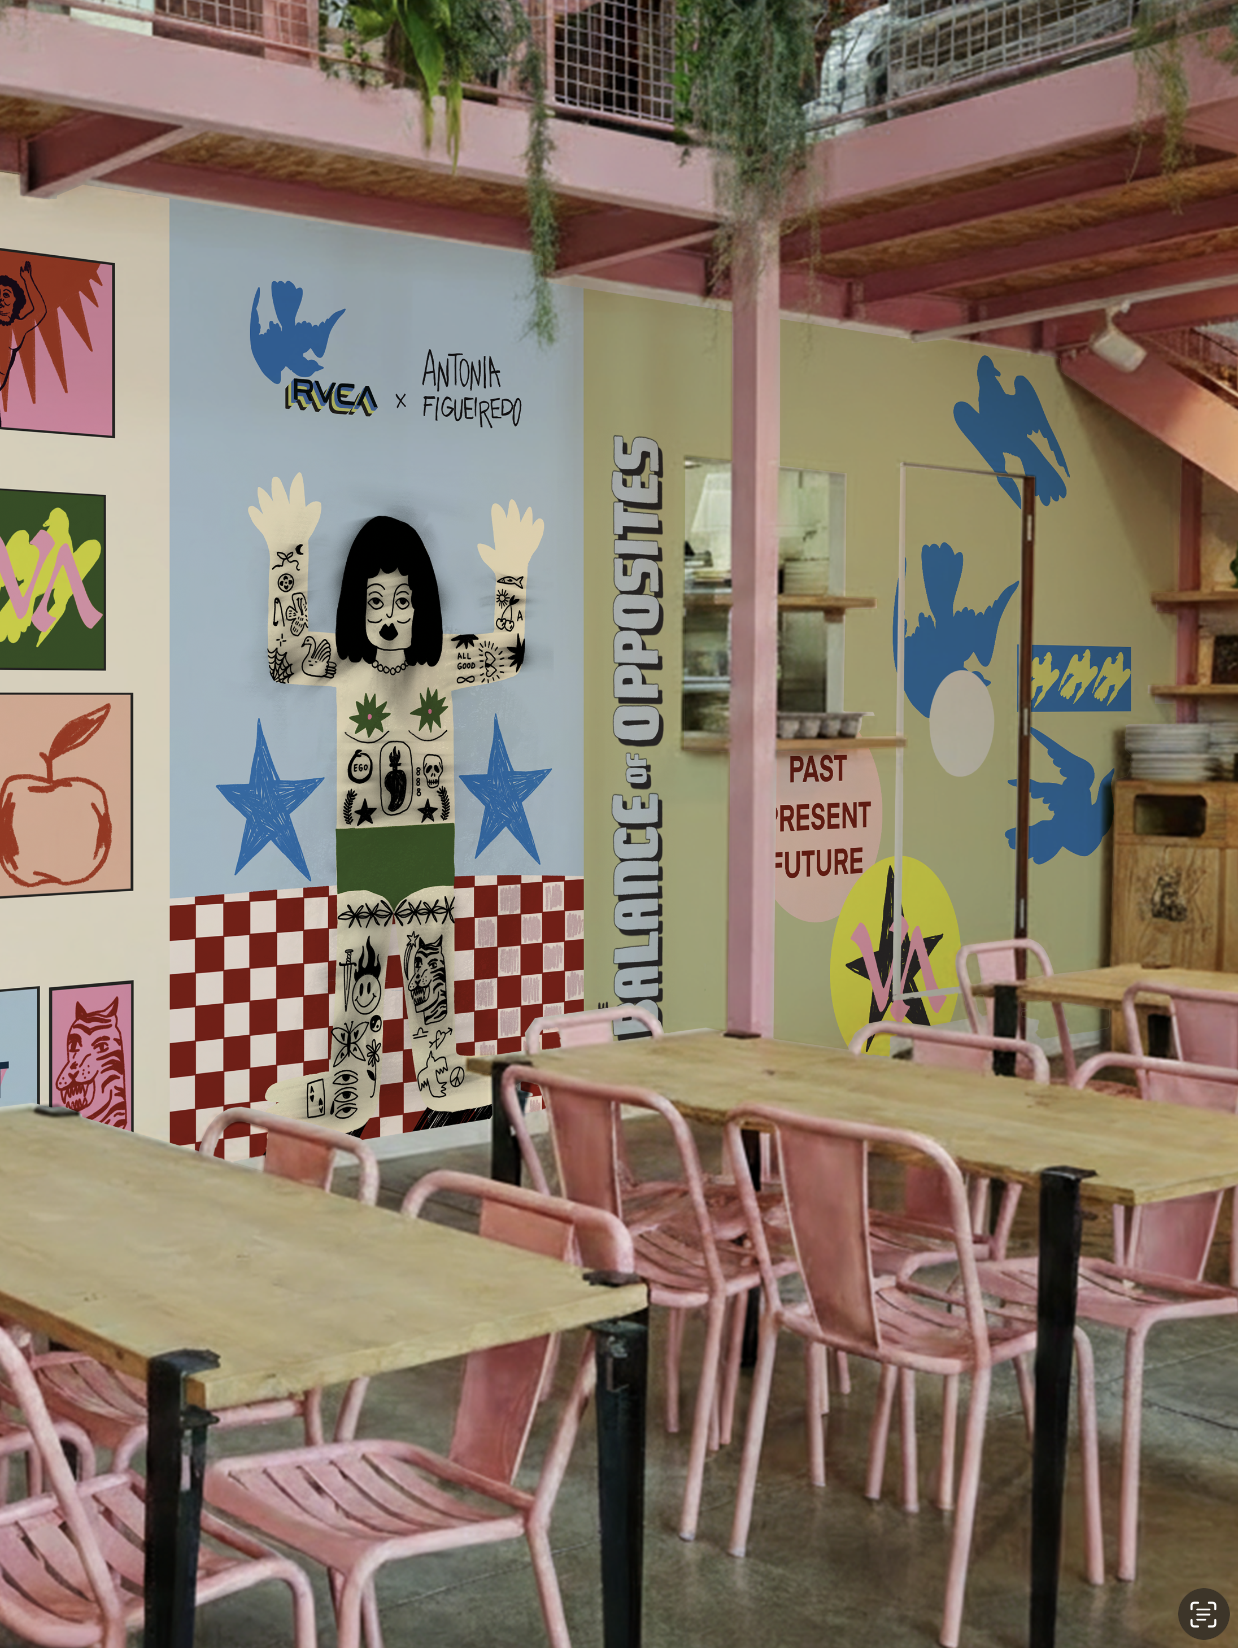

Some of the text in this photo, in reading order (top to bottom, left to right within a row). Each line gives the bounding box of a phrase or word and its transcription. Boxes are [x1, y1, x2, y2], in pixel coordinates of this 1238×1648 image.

[422, 349, 501, 392] ANTONIA
[423, 395, 522, 428] FIGUEIREDO
[612, 435, 664, 747] OPPOSITES
[457, 652, 471, 660] ALL
[457, 662, 476, 670] GOOD
[353, 764, 369, 772] EGO
[790, 754, 848, 783] PAST
[775, 801, 872, 832] RESENT
